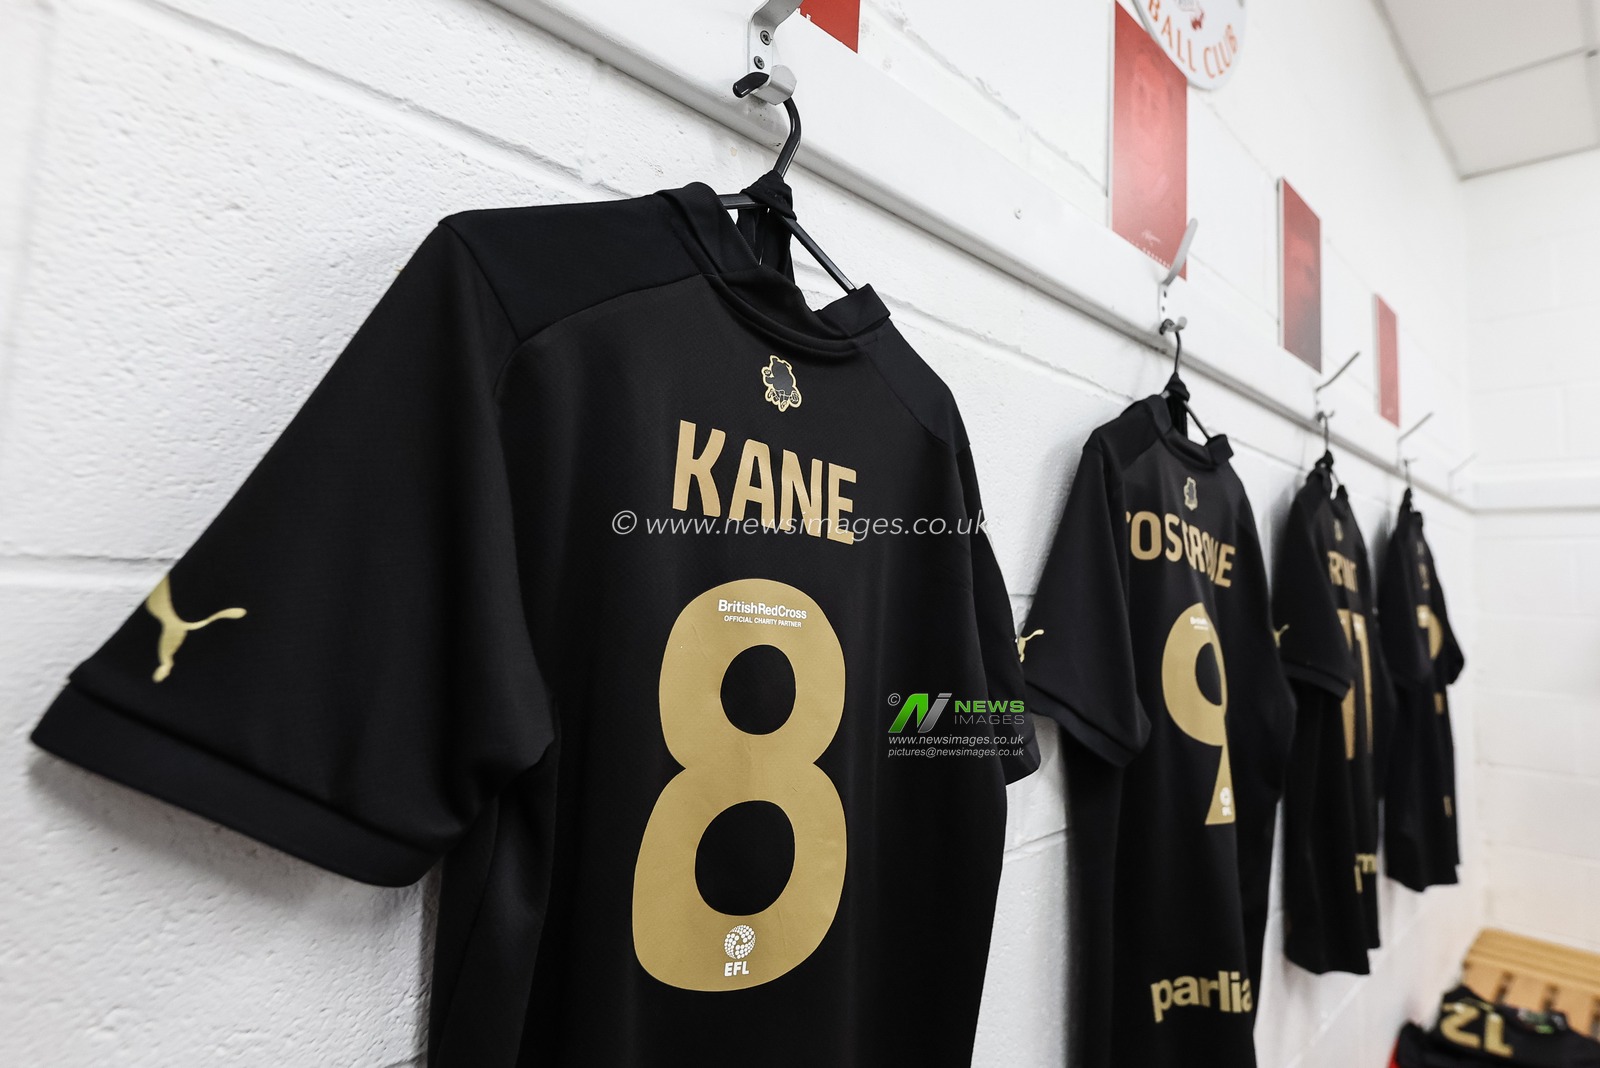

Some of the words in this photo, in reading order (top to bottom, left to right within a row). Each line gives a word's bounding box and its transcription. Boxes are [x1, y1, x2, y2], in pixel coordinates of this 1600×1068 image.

[672, 419, 857, 545] KANE
[723, 615, 753, 623] OFFICIAL
[753, 617, 778, 626] CHARITY
[777, 619, 802, 628] PARTNER
[1161, 602, 1236, 825] 9
[632, 578, 847, 992] 8
[724, 960, 750, 977] EFL
